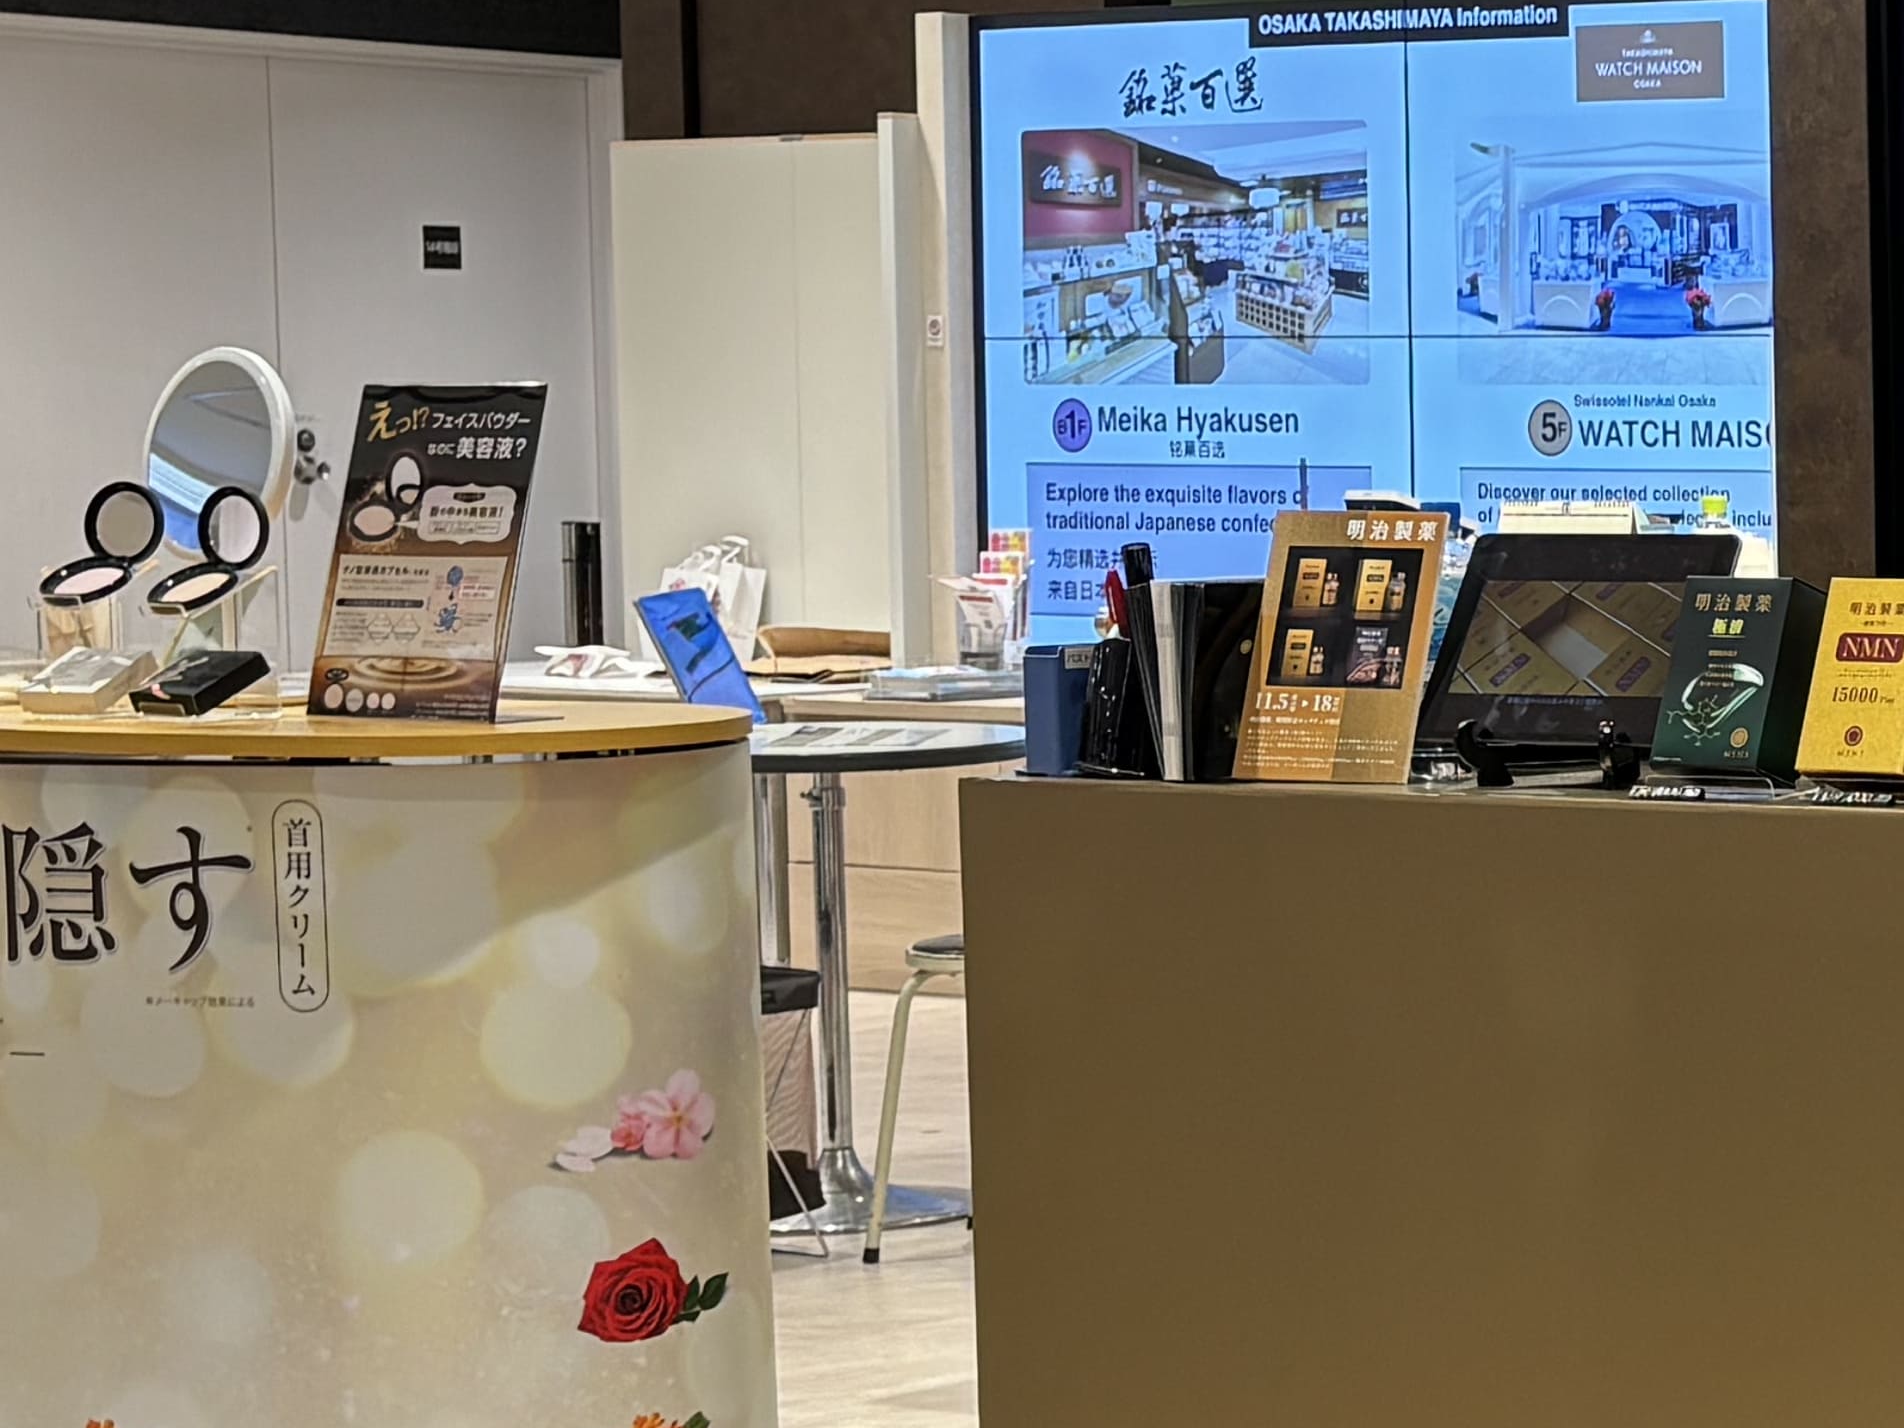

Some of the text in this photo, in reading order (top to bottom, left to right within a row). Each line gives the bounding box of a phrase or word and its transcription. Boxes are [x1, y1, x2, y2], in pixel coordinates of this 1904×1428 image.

[1259, 5, 1558, 35] OSAKA TAKASHIMAYA Information
[1595, 59, 1702, 76] WATCH MAISON
[1098, 406, 1167, 432] Meika
[1177, 407, 1299, 440] Hyakusen
[1541, 412, 1568, 444] 5F
[1579, 421, 1680, 449] WATCH
[1046, 483, 1110, 507] Explore
[1114, 483, 1140, 502] the
[1145, 483, 1222, 507] exquisite
[1227, 483, 1287, 505] flavors
[1046, 511, 1130, 531] traditional
[1135, 513, 1215, 535] Japanese
[1478, 507, 1492, 523] of
[1347, 519, 1436, 542] 明治製薬
[1695, 593, 1773, 613] 明治製薬
[1842, 637, 1900, 657] NMN
[1832, 687, 1879, 702] 15000
[2, 821, 255, 973] 隠す
[281, 816, 316, 999] 首用クリーム
